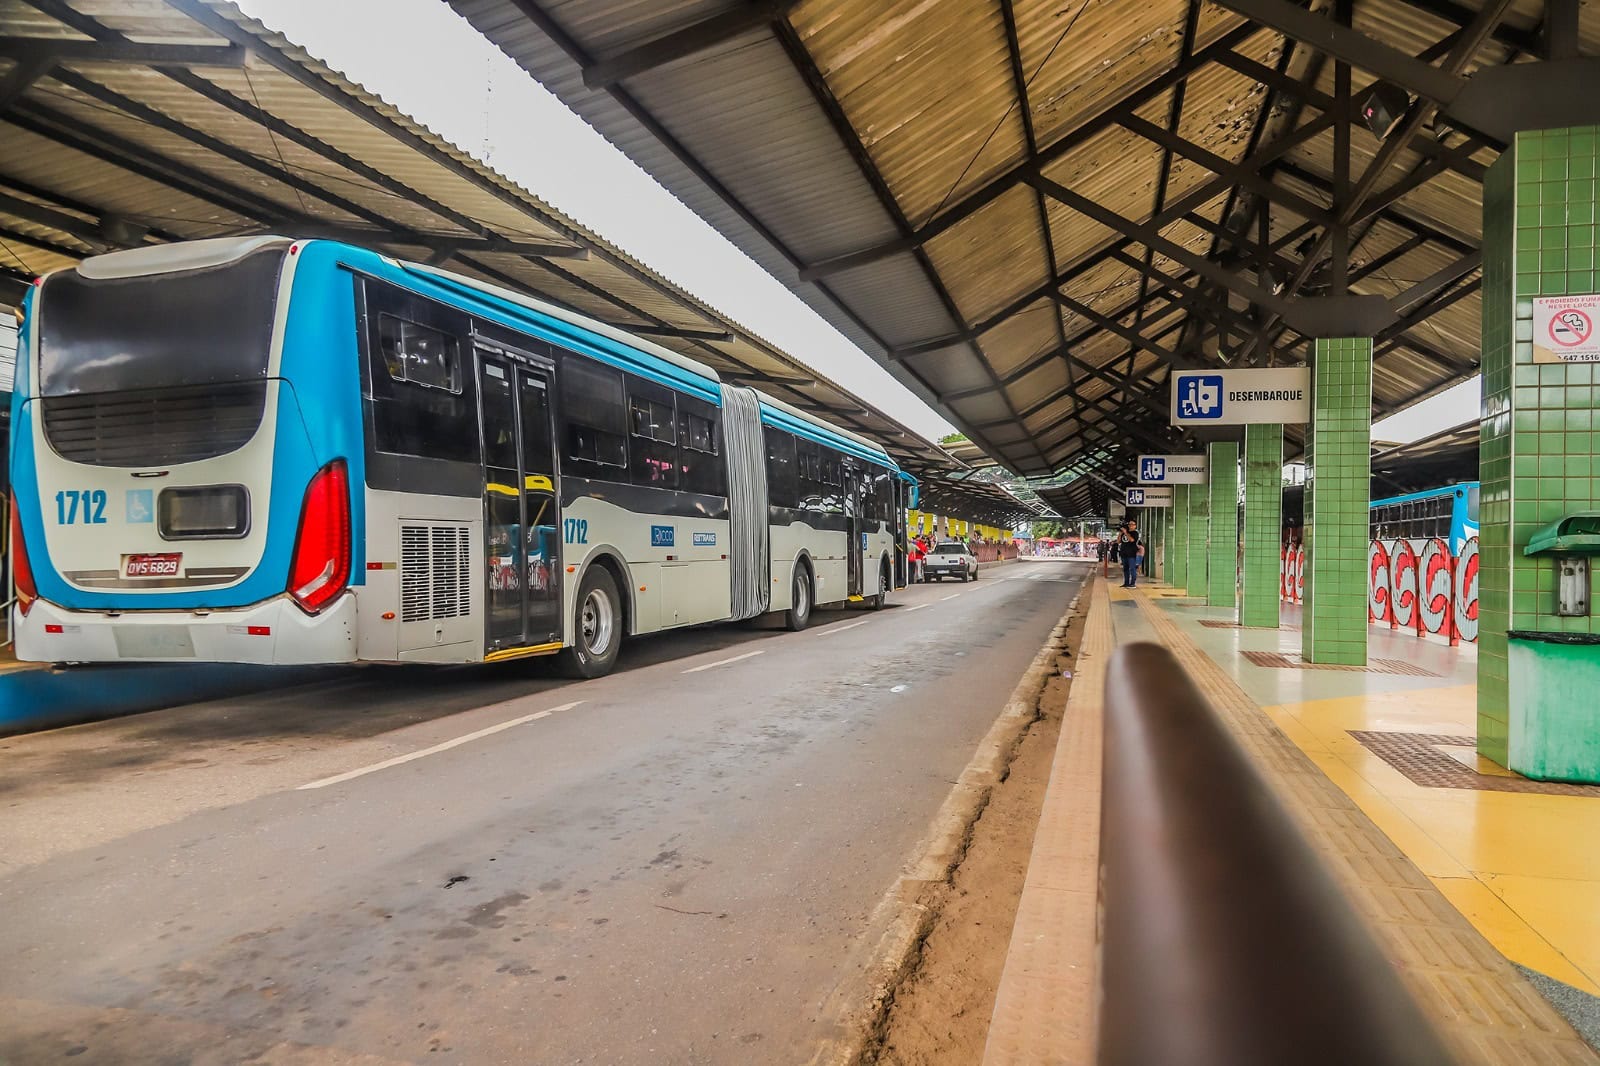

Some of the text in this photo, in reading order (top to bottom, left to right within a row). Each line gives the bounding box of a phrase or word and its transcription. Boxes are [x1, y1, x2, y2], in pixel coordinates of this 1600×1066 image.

[1229, 390, 1303, 402] DESEMBARQUE
[55, 489, 107, 525] 1712
[563, 518, 588, 544] 1712
